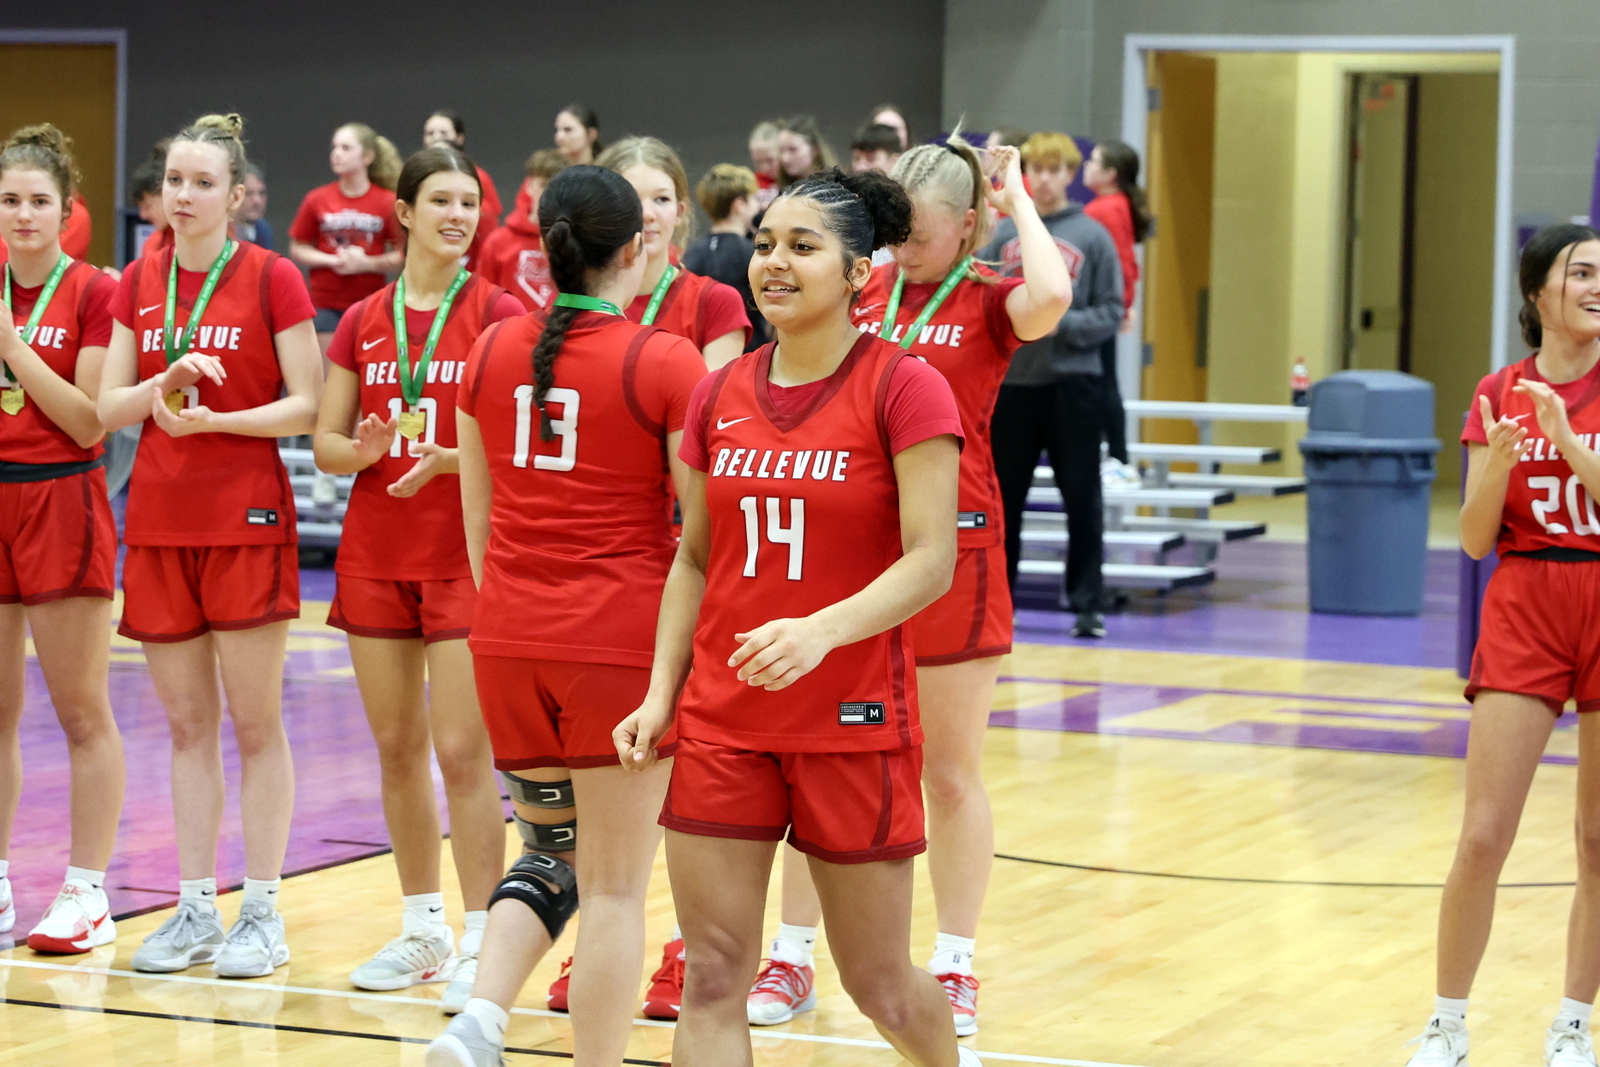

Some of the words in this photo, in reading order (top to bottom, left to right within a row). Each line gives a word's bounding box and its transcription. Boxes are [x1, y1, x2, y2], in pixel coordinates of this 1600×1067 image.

[142, 325, 242, 353] BELVUE
[365, 360, 466, 386] BELVUE
[387, 397, 437, 457] 10
[513, 384, 580, 472] 13
[712, 448, 850, 481] BELLEVUE
[1527, 474, 1600, 536] 20
[740, 496, 804, 580] 14
[870, 708, 879, 718] M
